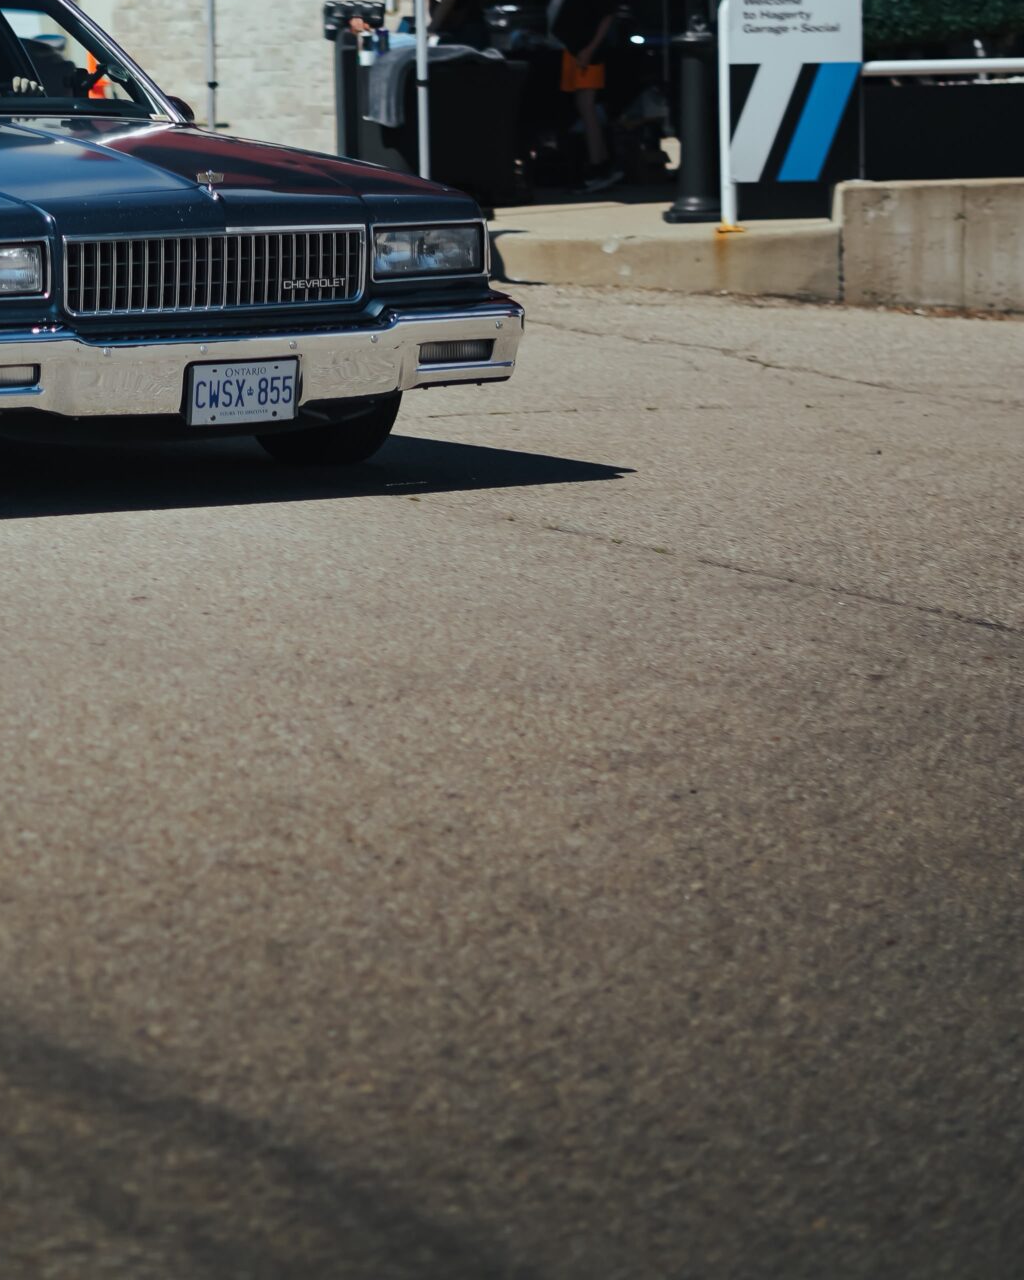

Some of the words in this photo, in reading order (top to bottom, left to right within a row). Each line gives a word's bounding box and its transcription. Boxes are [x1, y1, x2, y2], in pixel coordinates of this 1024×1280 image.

[742, 11, 757, 20] to
[759, 10, 812, 21] Hagerty
[742, 23, 789, 35] Garage
[800, 23, 841, 33] Social
[283, 277, 346, 290] CHEVROLET
[225, 367, 267, 377] ONTARIO
[195, 379, 245, 409] CWSX
[257, 375, 293, 405] 855
